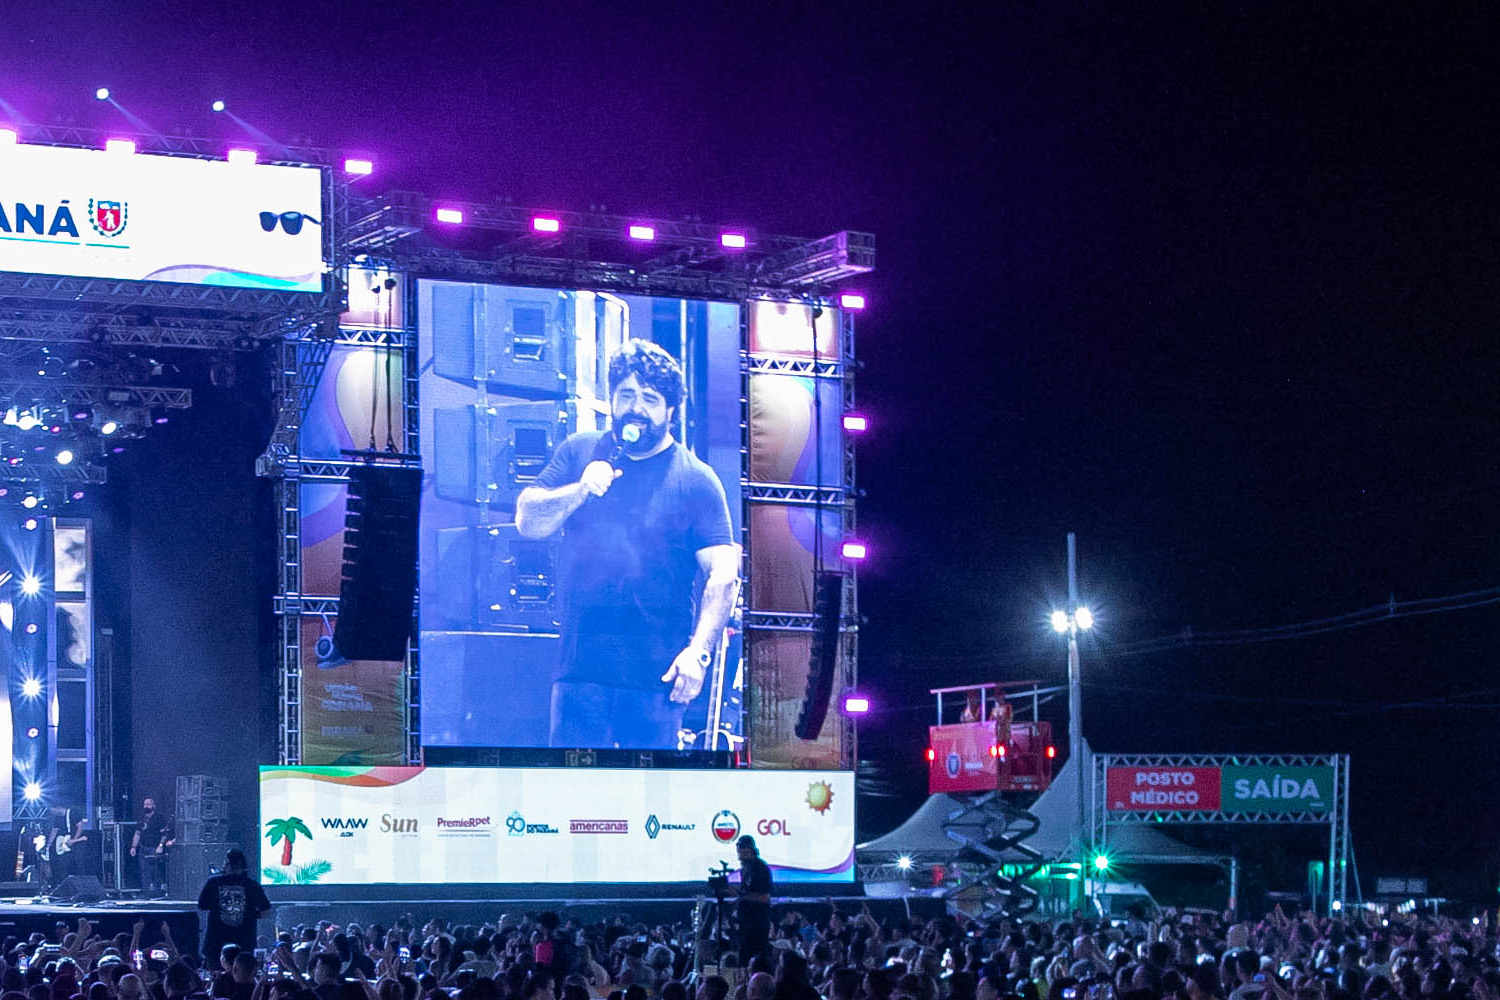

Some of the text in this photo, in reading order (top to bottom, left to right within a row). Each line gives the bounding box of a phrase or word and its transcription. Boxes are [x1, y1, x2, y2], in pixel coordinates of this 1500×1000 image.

[1136, 772, 1195, 786] POSTO
[1234, 774, 1320, 799] SAÍDA
[1130, 788, 1200, 805] MÉDICO
[321, 817, 369, 829] WAAW
[380, 813, 419, 833] Sun
[661, 823, 696, 831] RENAULT
[757, 819, 792, 836] GOL
